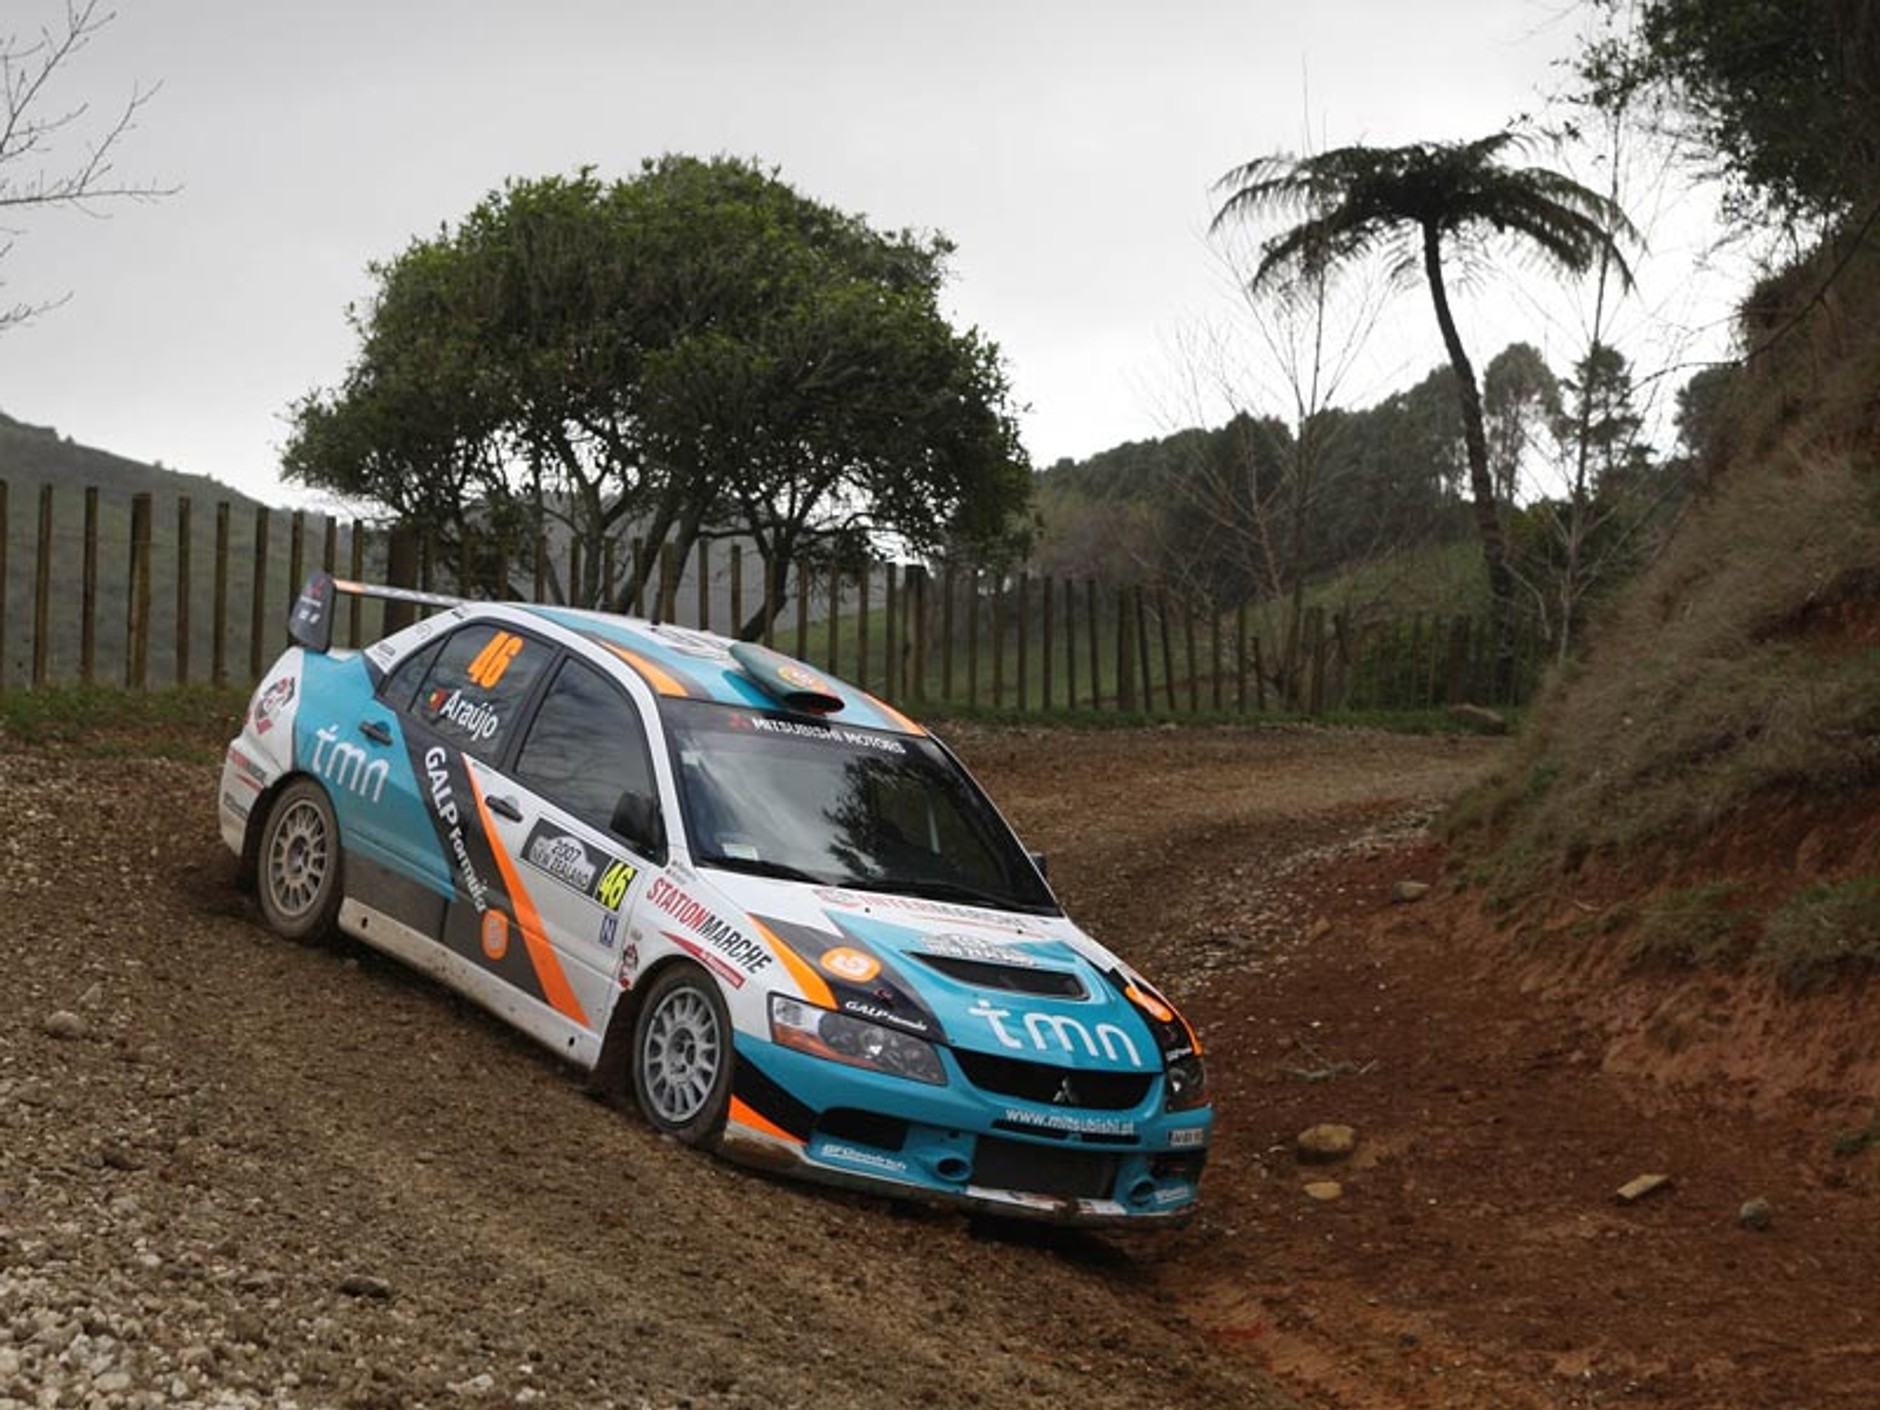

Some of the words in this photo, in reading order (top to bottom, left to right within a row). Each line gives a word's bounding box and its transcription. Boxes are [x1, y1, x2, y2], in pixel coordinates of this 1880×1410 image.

[466, 630, 523, 688] 46
[440, 689, 499, 741] Araújo
[312, 723, 389, 802] tmn
[425, 746, 459, 827] GALP
[598, 861, 635, 909] 46
[646, 877, 773, 975] STATIONMARCHE
[968, 998, 1142, 1068] tmn
